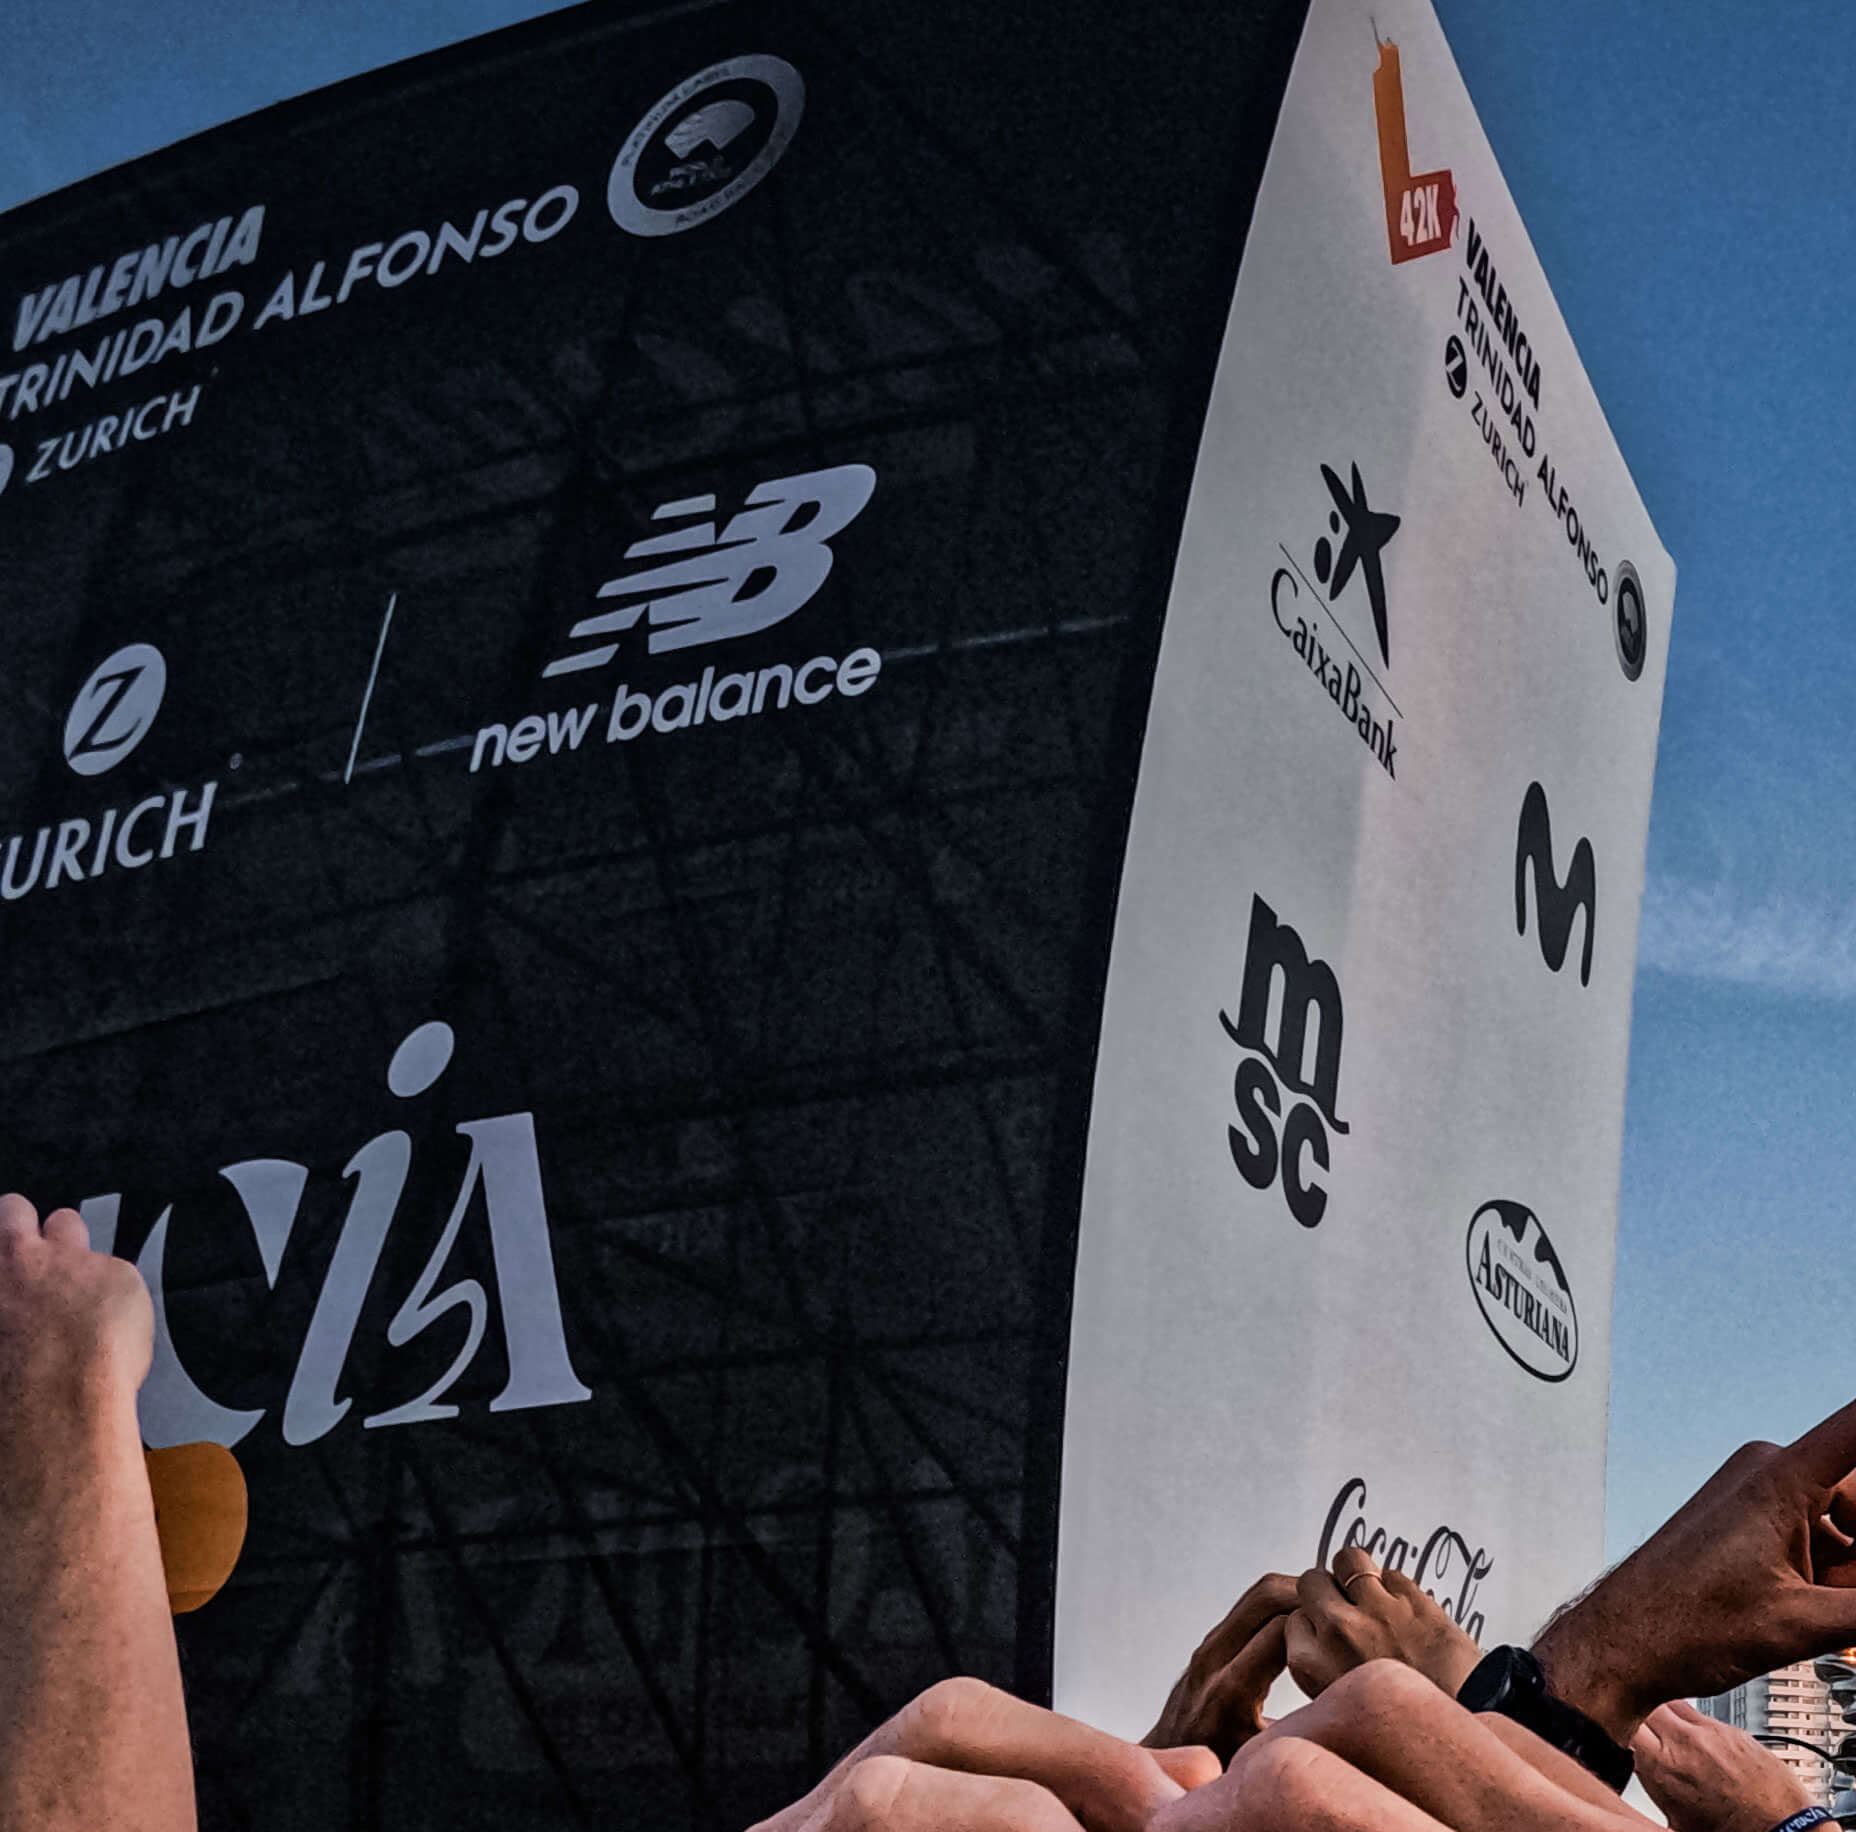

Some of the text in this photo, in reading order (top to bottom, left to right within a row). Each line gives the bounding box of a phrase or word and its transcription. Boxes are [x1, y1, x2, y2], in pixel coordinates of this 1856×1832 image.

[14, 206, 266, 351] VALENCIA
[1399, 184, 1442, 246] 42K
[0, 185, 580, 417] TRINIDAD ALFONSO
[1467, 218, 1541, 411] VALENCIA
[25, 386, 201, 483] ZURICH
[1454, 276, 1608, 606] TRINIDAD ALFONSO
[1470, 391, 1525, 508] ZURICH
[468, 648, 882, 773] new balance
[1270, 566, 1398, 782] CaixaBank
[0, 782, 217, 897] URICH
[1475, 1230, 1570, 1364] ASTURIANA
